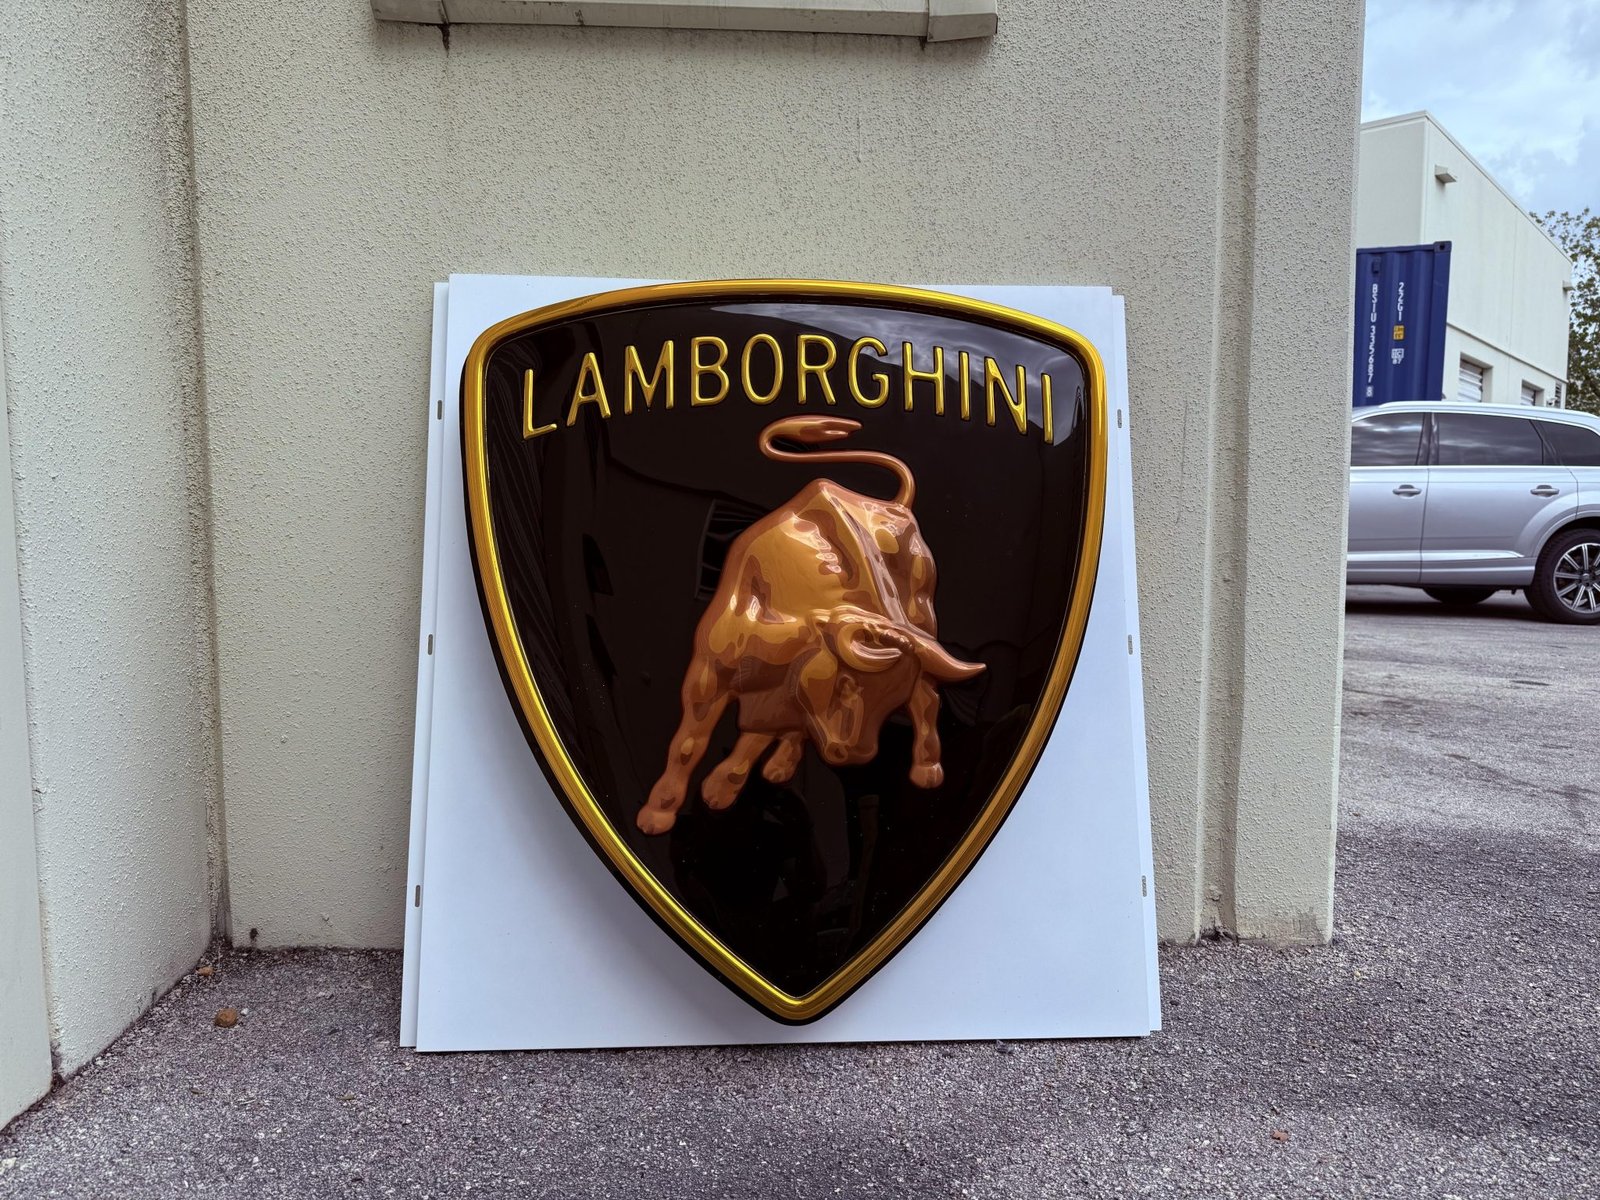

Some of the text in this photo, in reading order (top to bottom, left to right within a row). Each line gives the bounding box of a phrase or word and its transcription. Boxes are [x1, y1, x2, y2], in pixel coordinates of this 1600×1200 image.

[1370, 283, 1378, 323] BSIU
[1367, 325, 1376, 384] 335687
[522, 332, 1055, 445] LAMBORGHINI
